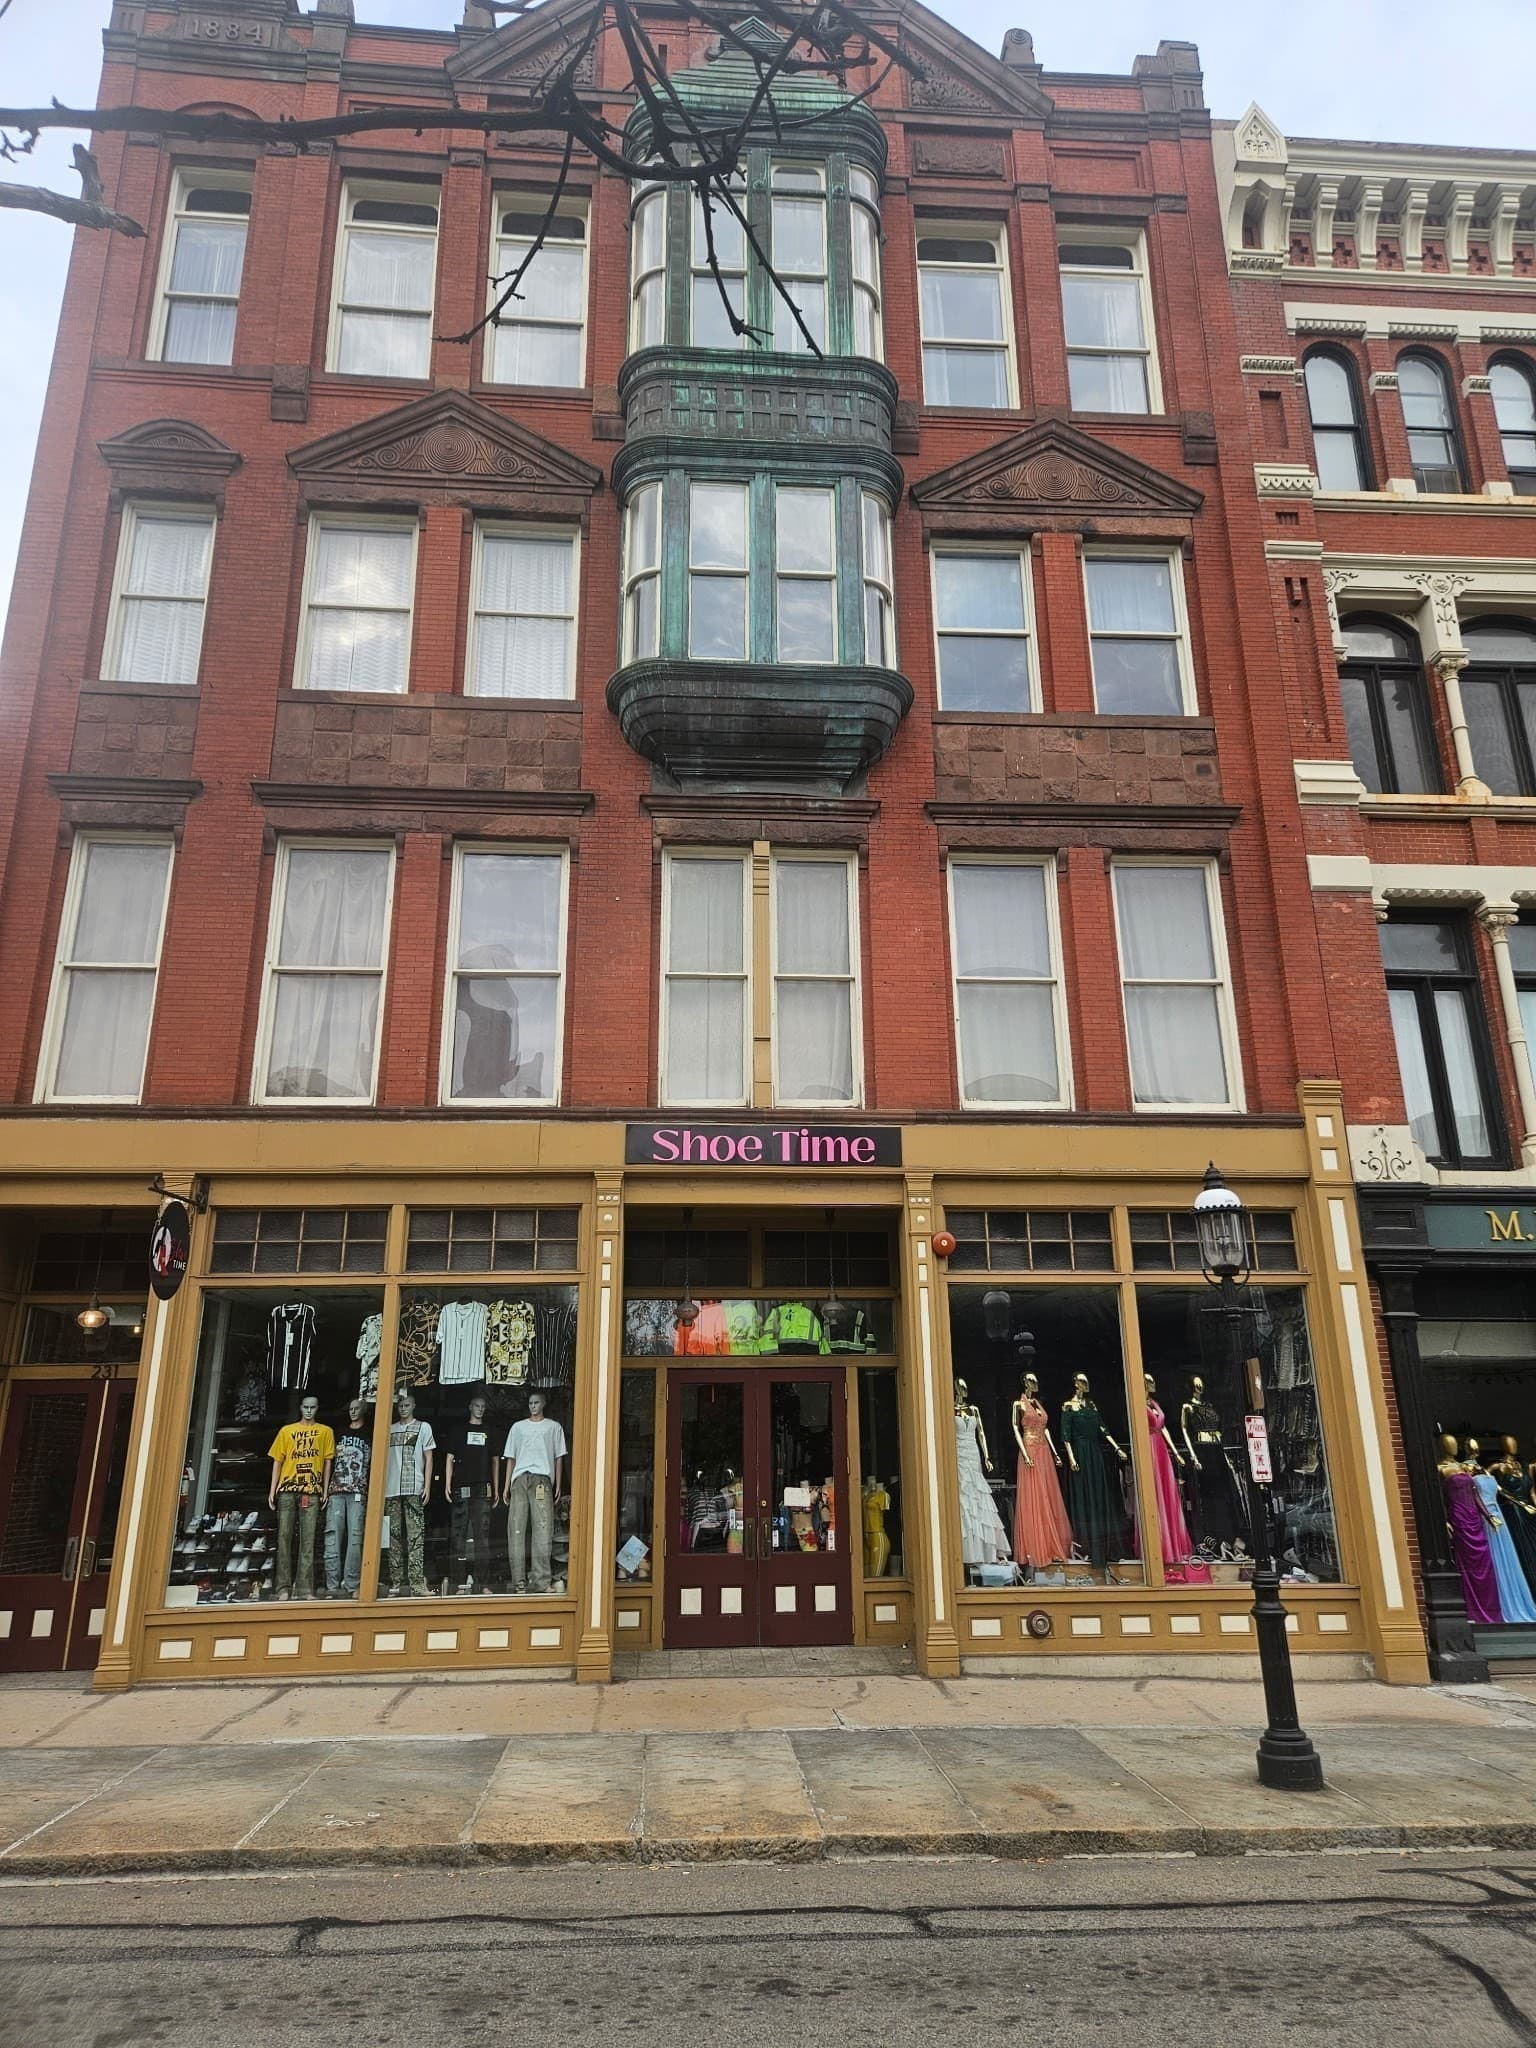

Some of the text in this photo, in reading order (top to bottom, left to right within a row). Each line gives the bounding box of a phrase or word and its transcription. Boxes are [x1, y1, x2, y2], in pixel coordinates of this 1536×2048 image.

[191, 18, 264, 45] 1884
[652, 1128, 876, 1163] Shoe Time
[173, 1259, 187, 1271] TIME
[91, 1364, 119, 1379] 231
